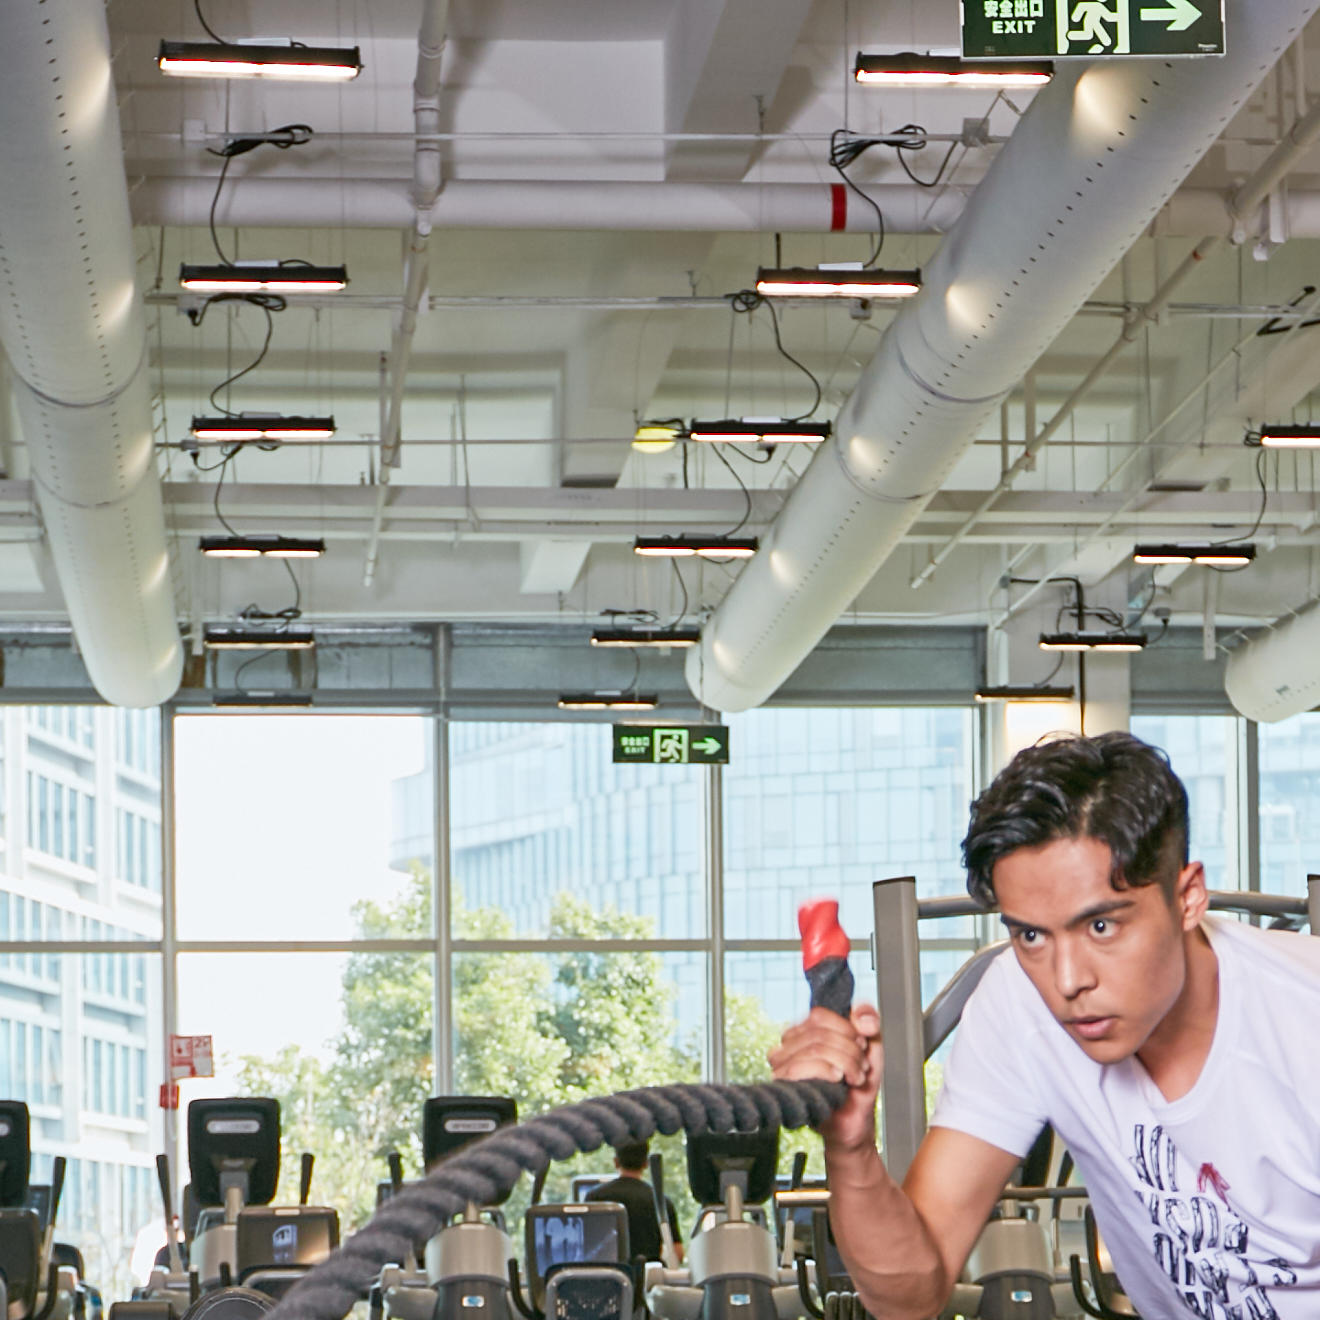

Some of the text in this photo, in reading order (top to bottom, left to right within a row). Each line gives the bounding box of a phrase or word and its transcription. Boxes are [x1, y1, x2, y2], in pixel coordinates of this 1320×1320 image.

[983, 0, 1044, 18] 安全出口
[992, 20, 1036, 34] EXIT
